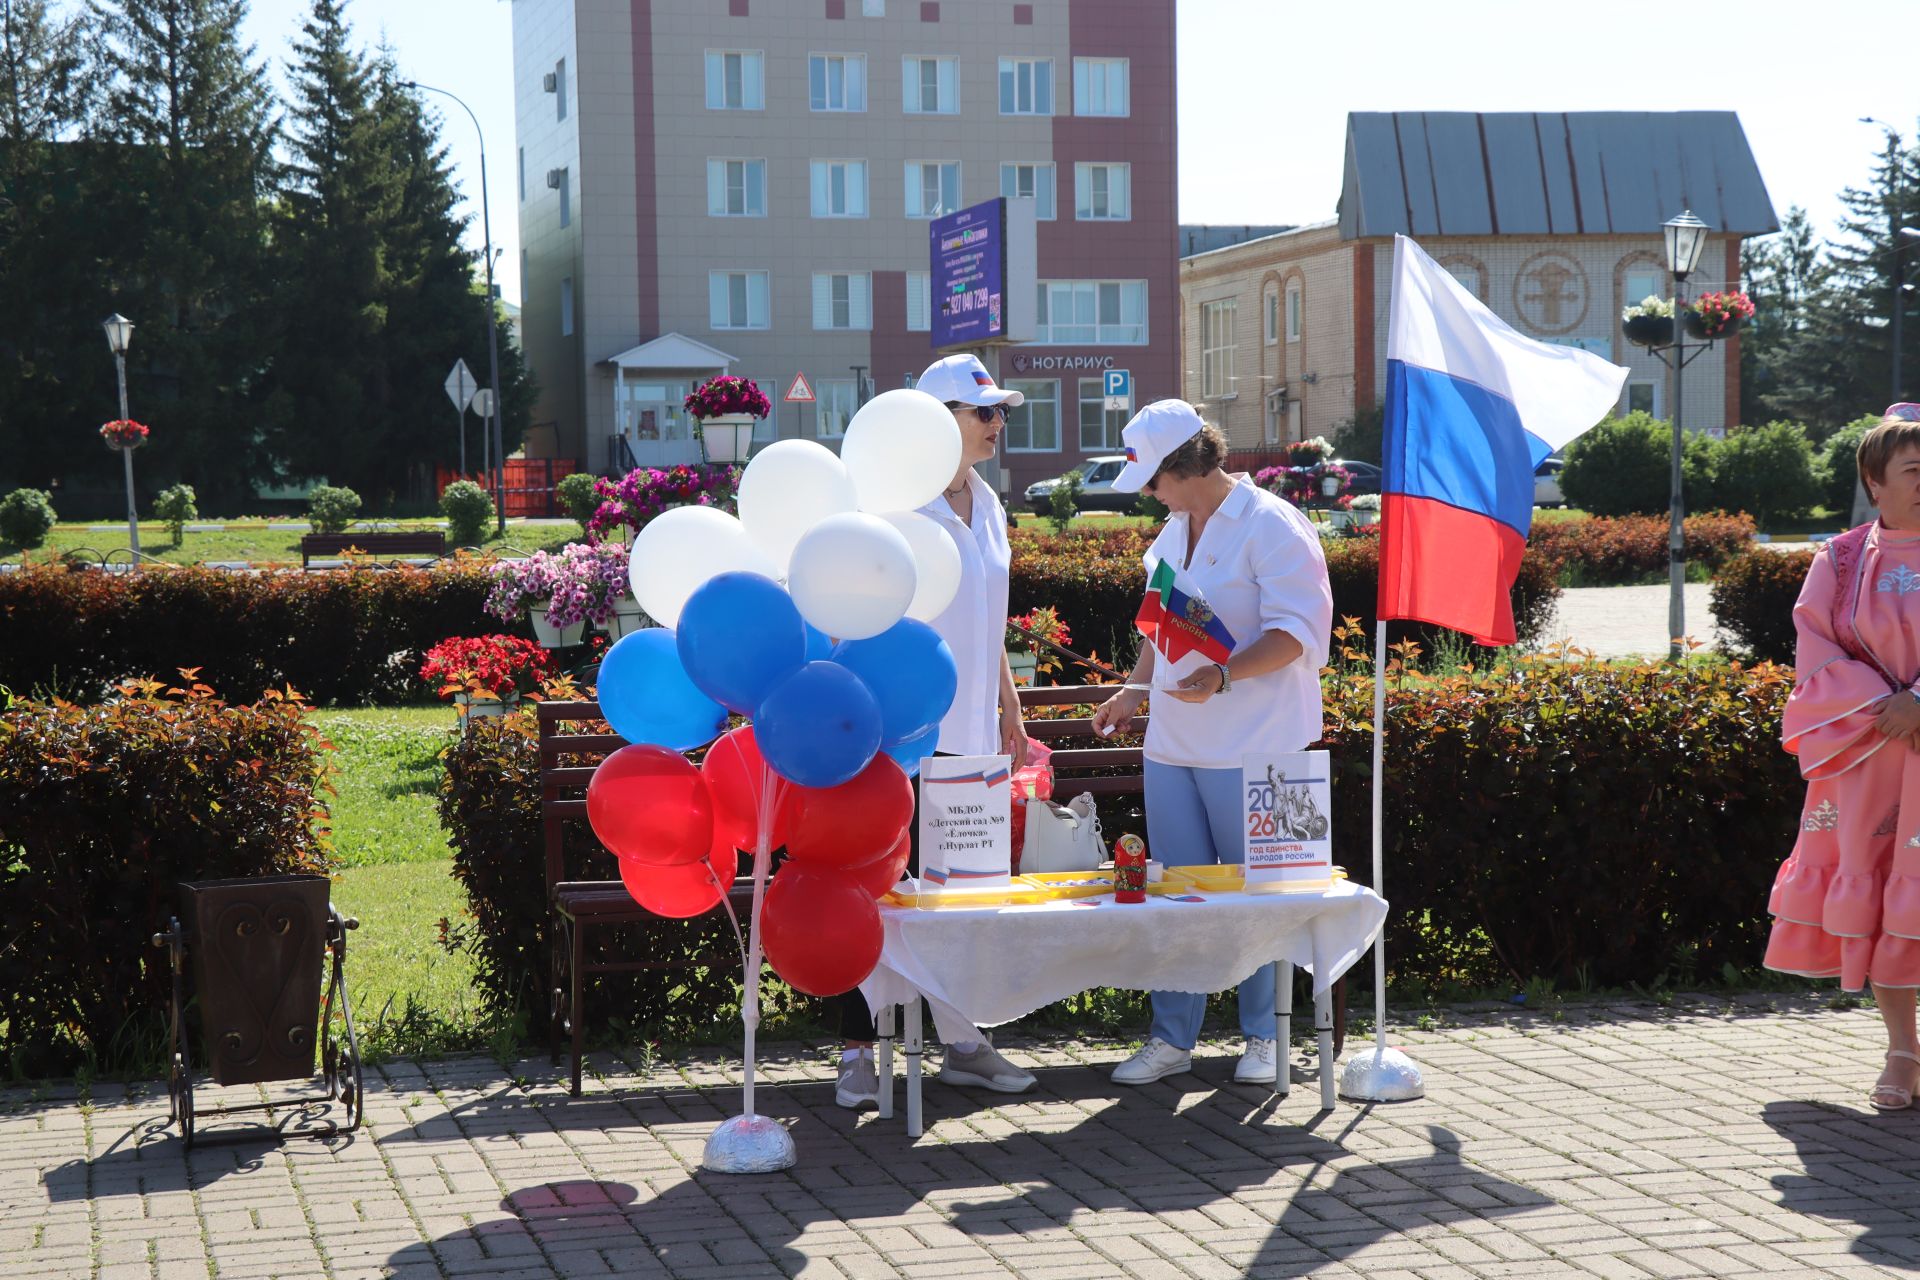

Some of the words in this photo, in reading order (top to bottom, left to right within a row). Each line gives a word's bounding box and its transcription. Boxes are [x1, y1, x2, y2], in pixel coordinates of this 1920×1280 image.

[951, 295, 961, 315] 927
[963, 291, 973, 312] 040
[974, 287, 988, 309] 7299
[1032, 356, 1114, 369] НОТАРИУС
[1109, 373, 1123, 394] P
[1248, 787, 1275, 812] 20
[948, 805, 985, 814] МБДОУ
[928, 817, 971, 828] «Детский
[973, 818, 988, 826] сад
[989, 816, 1005, 825] №9
[1248, 812, 1275, 837] 26
[945, 828, 988, 839] «Ёлочка»
[938, 842, 979, 852] г.Нурлат
[981, 840, 995, 849] РТ
[1249, 846, 1264, 854] ГОД
[1266, 844, 1303, 853] ЕДИНСТВА
[1249, 852, 1284, 862] НАРОДОВ
